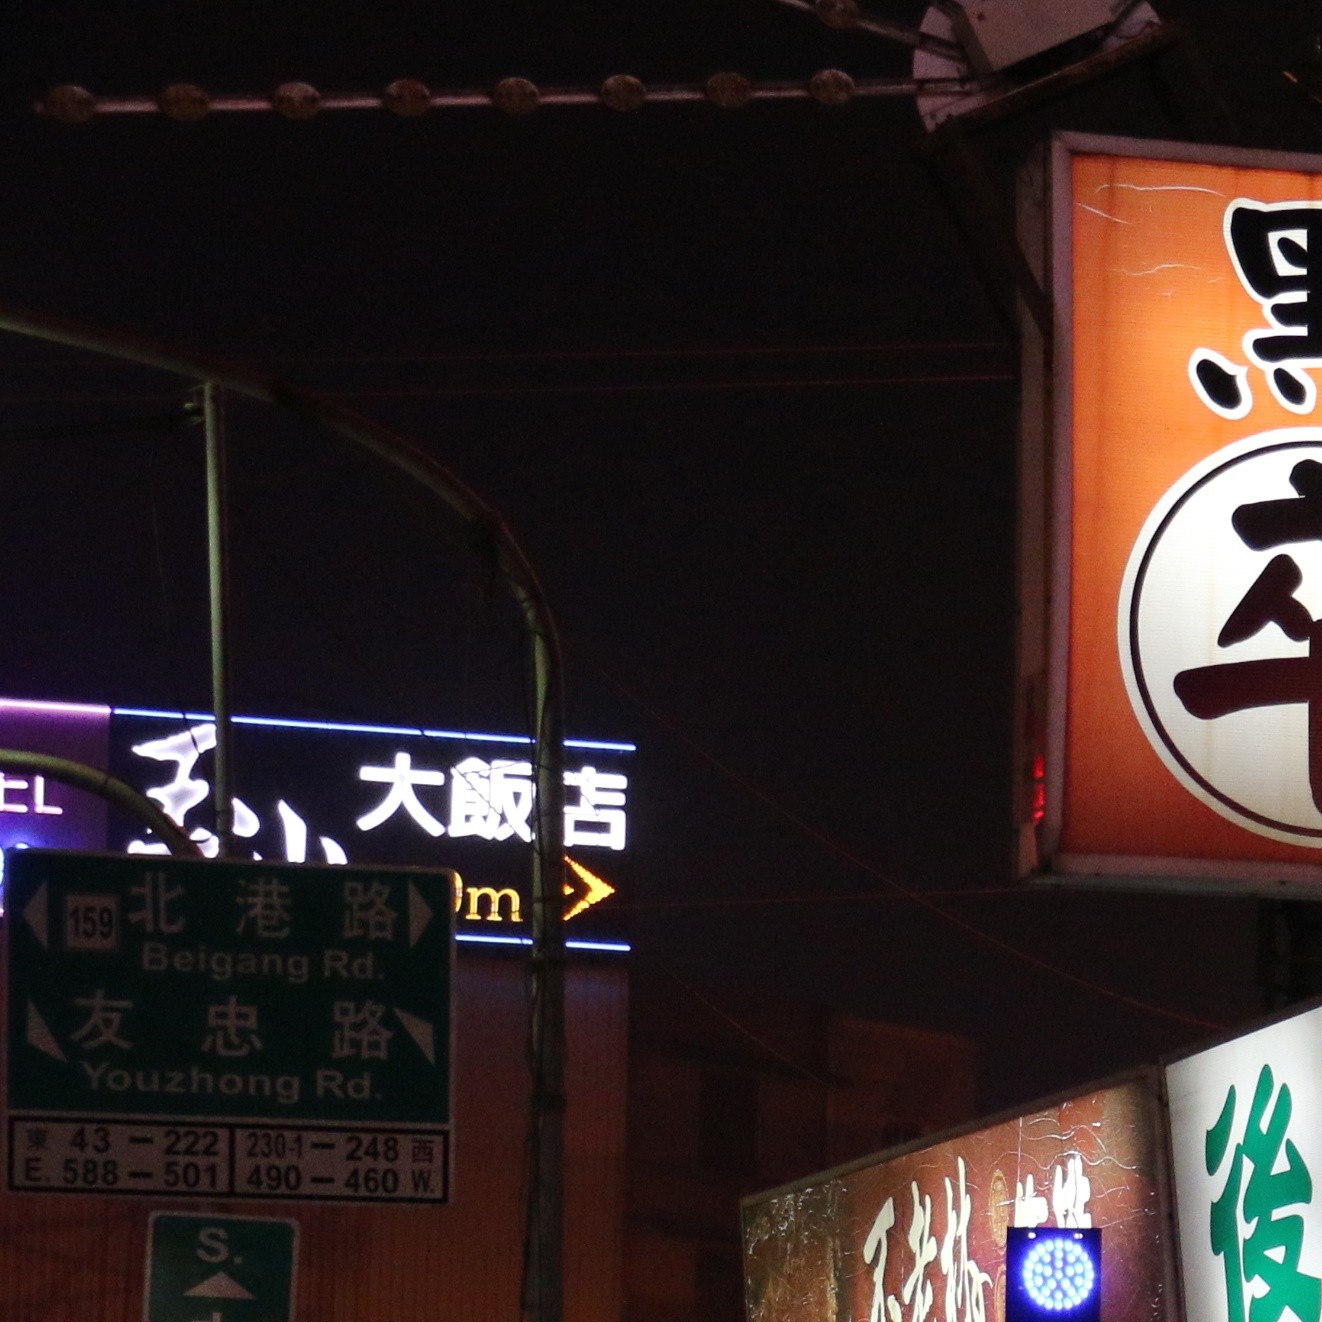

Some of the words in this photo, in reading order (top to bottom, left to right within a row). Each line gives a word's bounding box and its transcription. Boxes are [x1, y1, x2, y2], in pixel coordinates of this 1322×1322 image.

[70, 904, 114, 940] 159
[128, 871, 398, 942] 北港路
[141, 942, 310, 983] Beigang
[322, 948, 385, 980] Rd.
[69, 989, 395, 1061] 友忠路
[78, 1059, 301, 1105] Youzhong
[315, 1068, 384, 1100] Rd.
